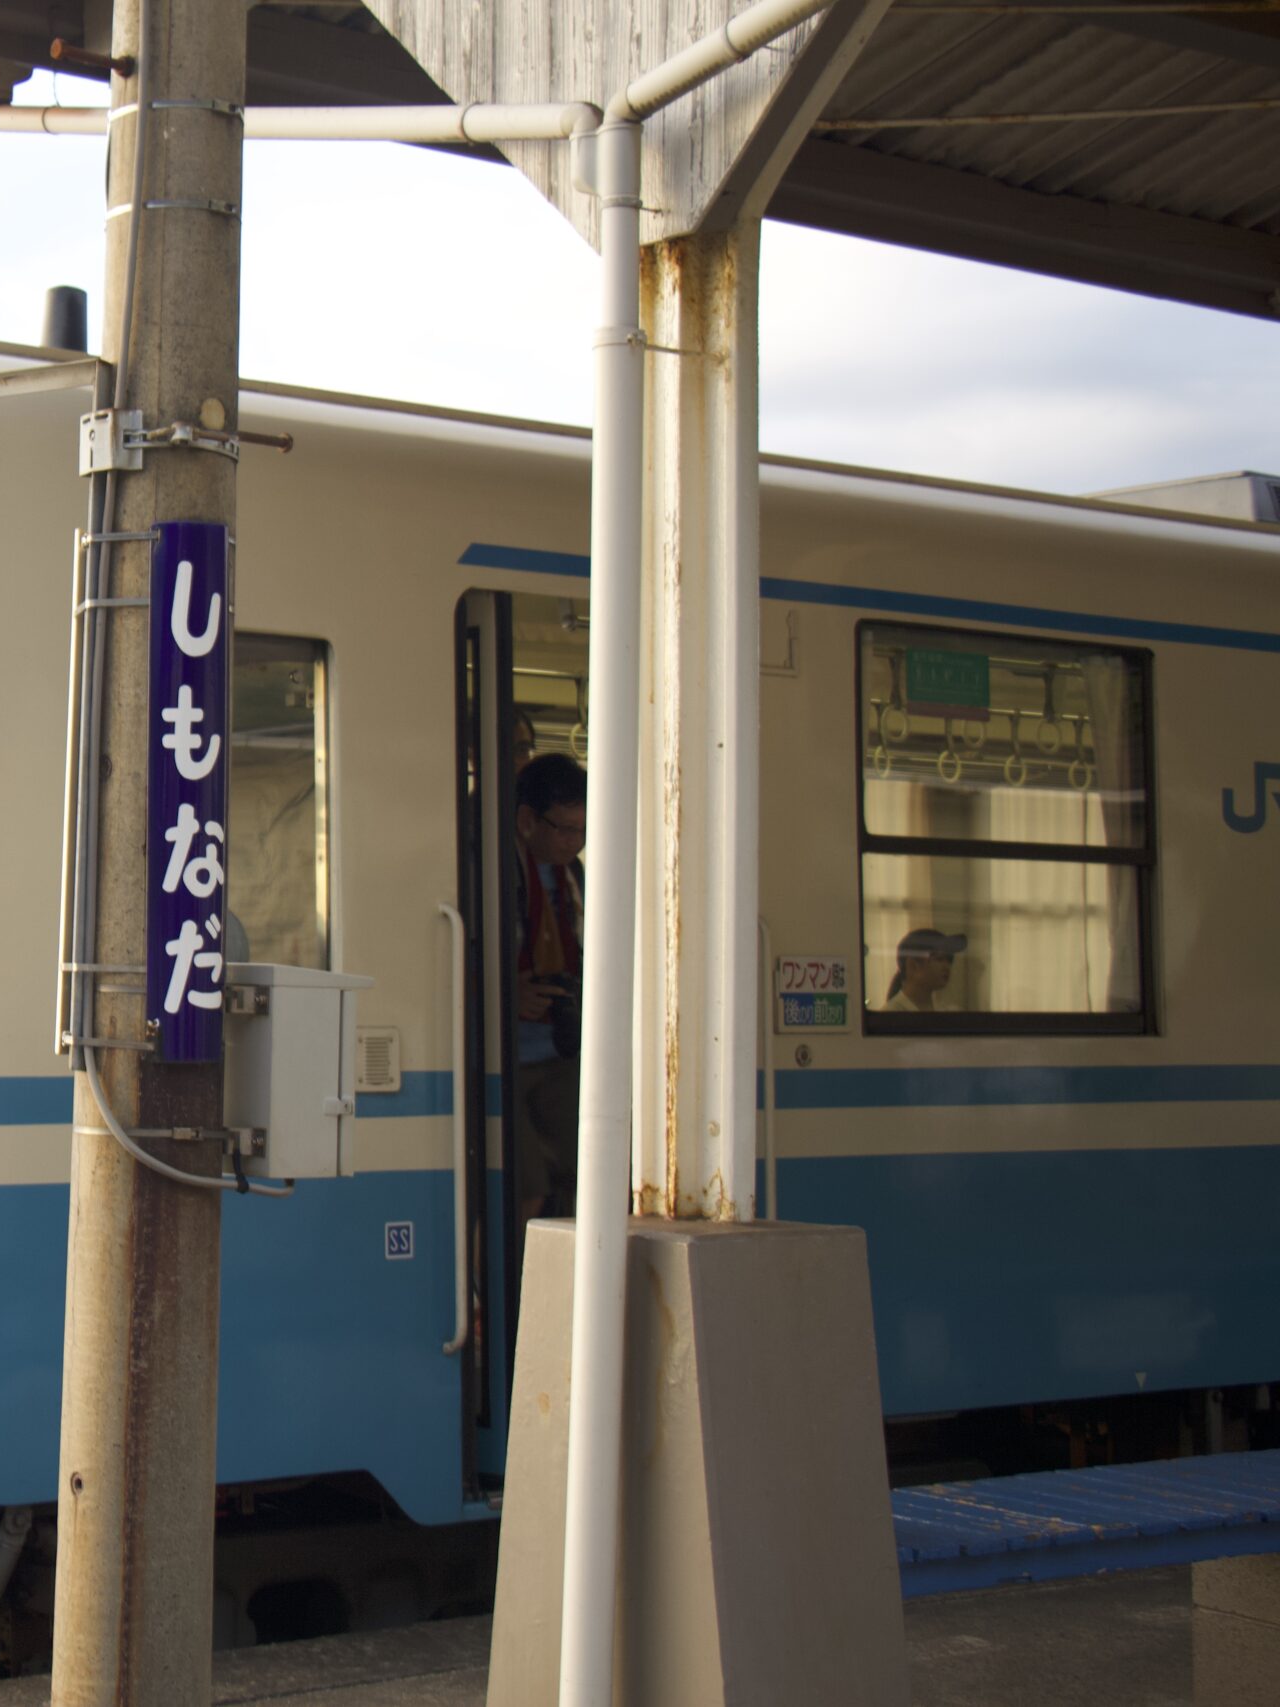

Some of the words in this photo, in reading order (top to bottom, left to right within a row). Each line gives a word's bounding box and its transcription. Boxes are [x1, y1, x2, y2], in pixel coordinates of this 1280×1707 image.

[161, 560, 224, 1014] しもなだ
[782, 962, 832, 989] ワンマン
[389, 1228, 409, 1251] SS
